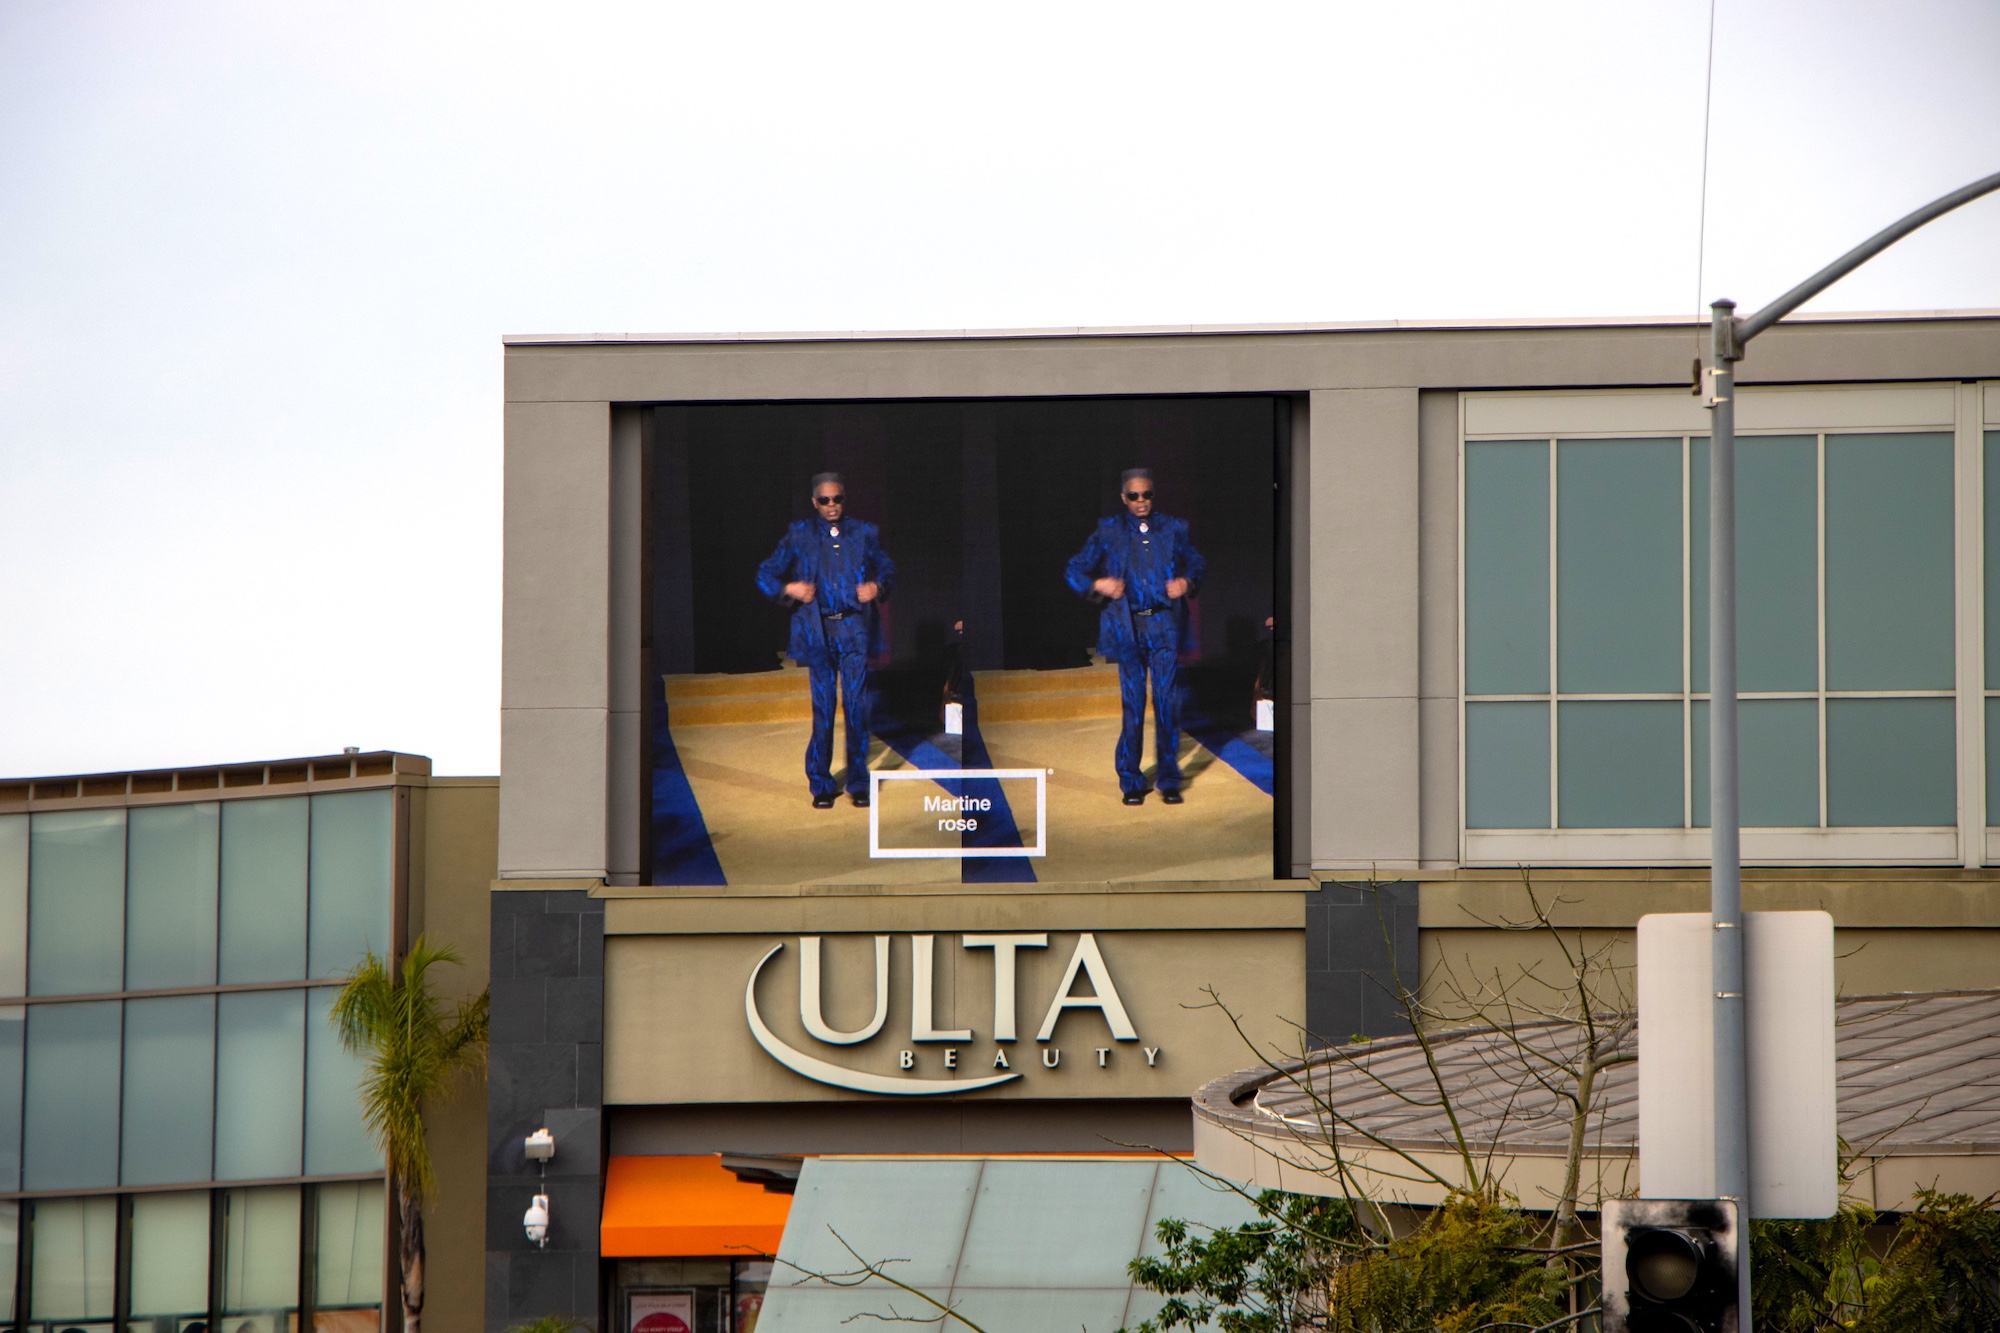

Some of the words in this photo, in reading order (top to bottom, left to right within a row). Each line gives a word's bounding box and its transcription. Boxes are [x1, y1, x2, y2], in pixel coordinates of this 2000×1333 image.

[923, 795, 991, 812] Martine
[938, 818, 977, 831] rose
[799, 933, 1139, 1045] ULTA
[899, 1048, 1160, 1069] BEAUTY
